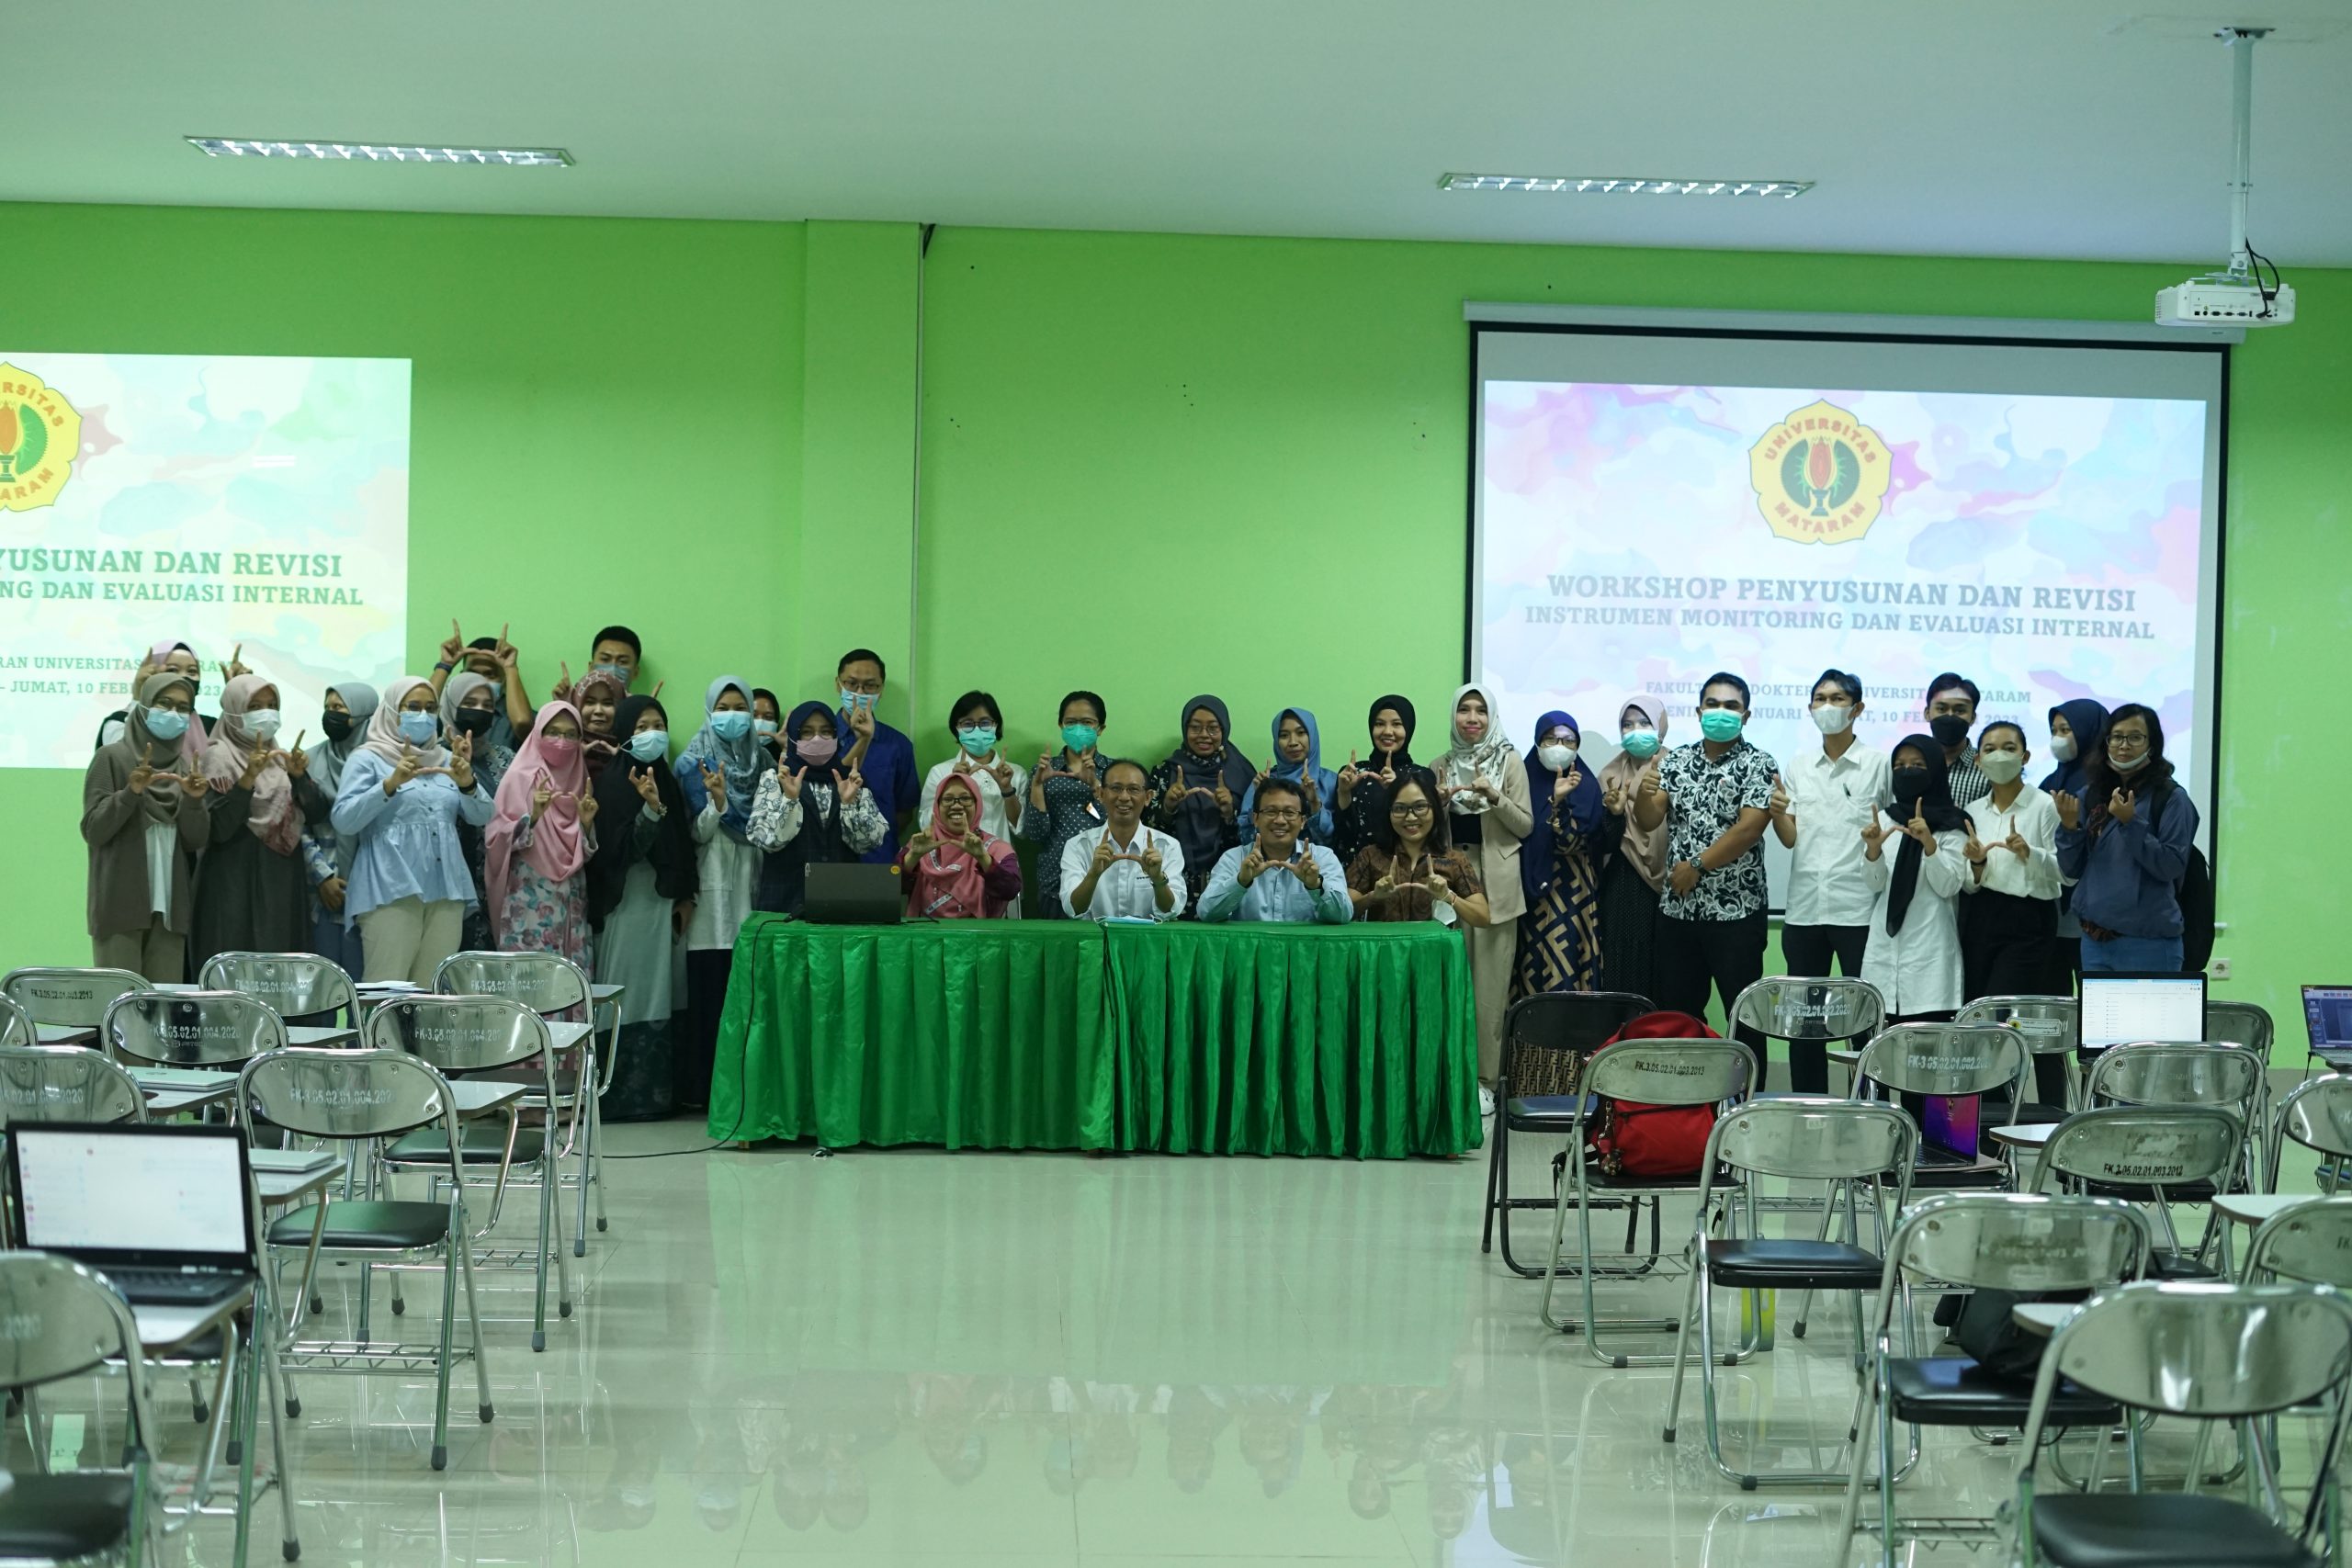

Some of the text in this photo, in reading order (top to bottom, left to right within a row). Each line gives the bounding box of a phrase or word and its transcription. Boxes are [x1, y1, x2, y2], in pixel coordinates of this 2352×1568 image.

[1764, 418, 1877, 463] UNIVERSITAS
[1774, 502, 1866, 534] MATARAM
[154, 551, 221, 574] DAN
[232, 553, 342, 578] REVISI
[42, 581, 94, 600] DAN
[103, 582, 224, 603] EVALUASI
[233, 585, 364, 606] INTERNAL
[1547, 574, 2135, 612] WORKSHOP PENYUSUNAN DAN REVISI
[1524, 606, 2155, 640] INSTRUMEN MONITORING DAN EVALUASI INTERNAL
[34, 657, 141, 671] UNIVERSITAS
[10, 681, 70, 695] JUMAT,
[77, 682, 93, 694] 10
[1645, 682, 1702, 694] FAKULT
[1883, 711, 1898, 722] 10
